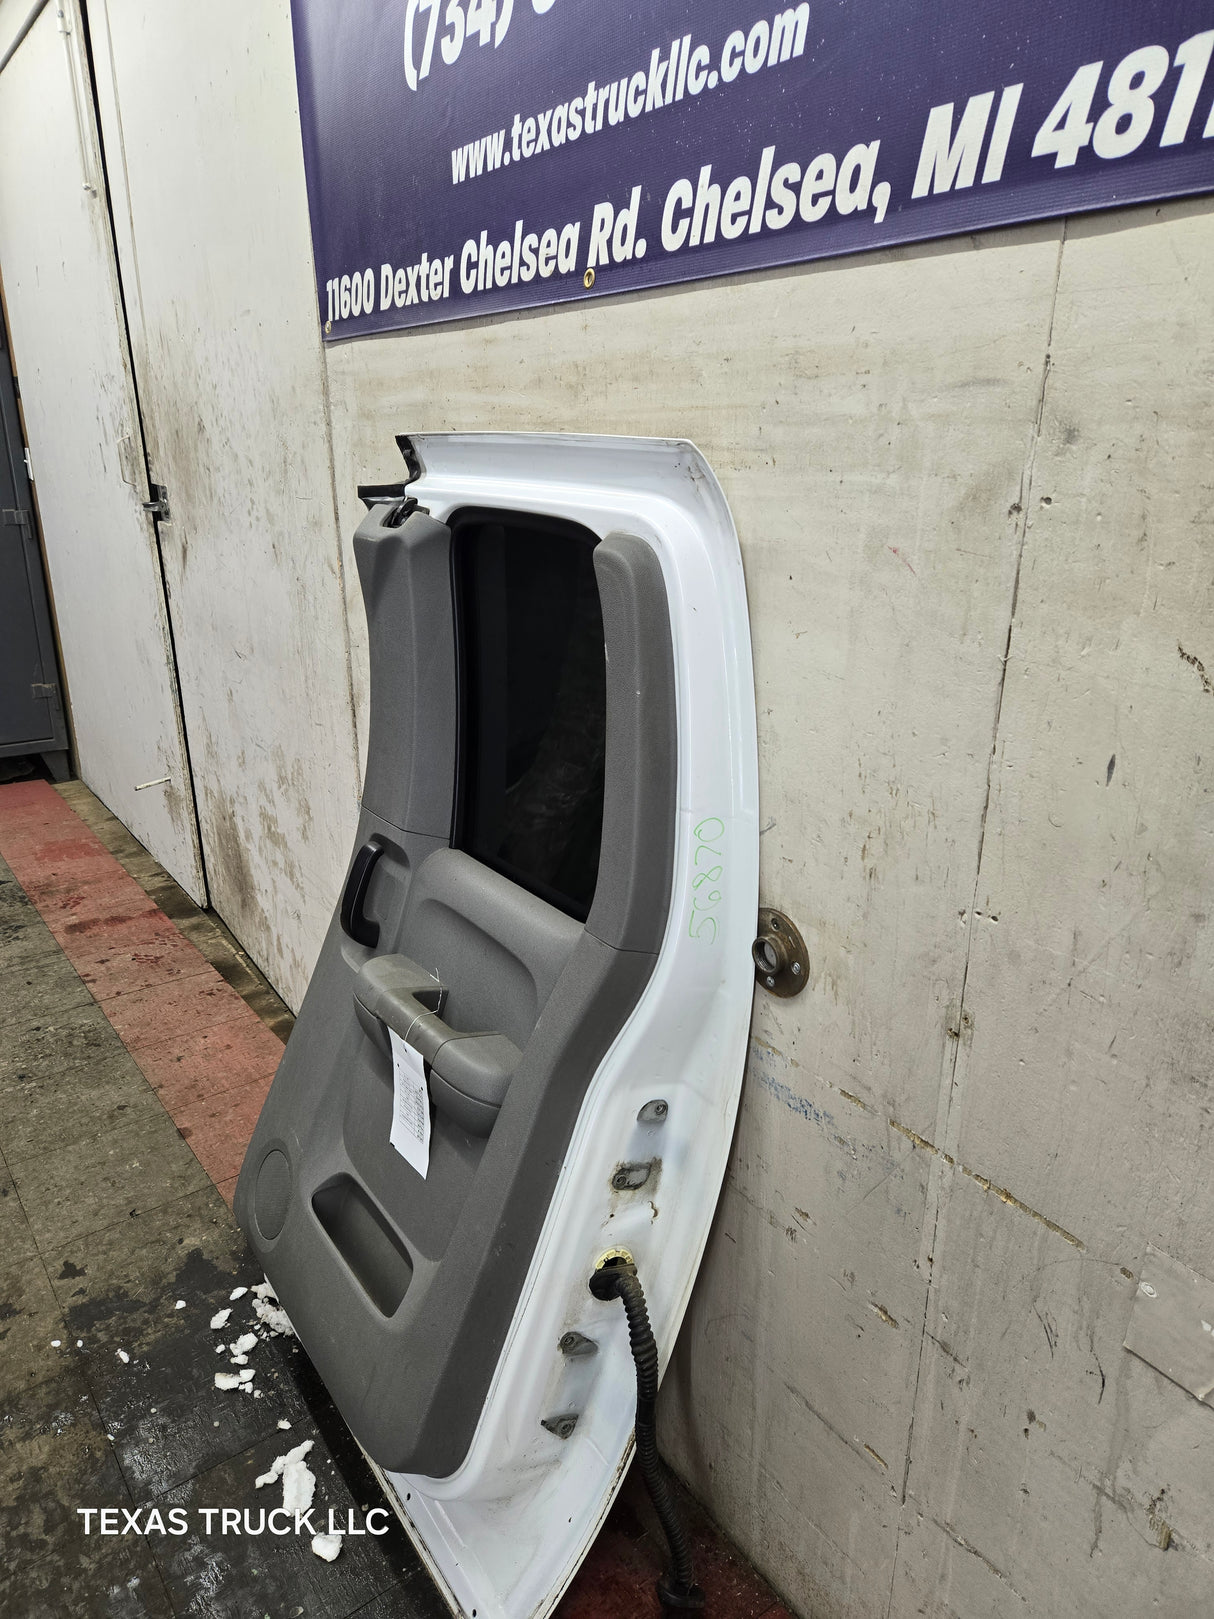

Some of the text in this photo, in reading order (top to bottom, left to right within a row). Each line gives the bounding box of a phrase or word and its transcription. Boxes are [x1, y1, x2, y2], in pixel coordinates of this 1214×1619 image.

[403, 0, 514, 91] (734)
[451, 2, 810, 185] www.texastruckllc.com
[326, 29, 1214, 322] 11600 Dexter Chelsea Rd. Chelsea, MI 481
[689, 817, 725, 945] 56870
